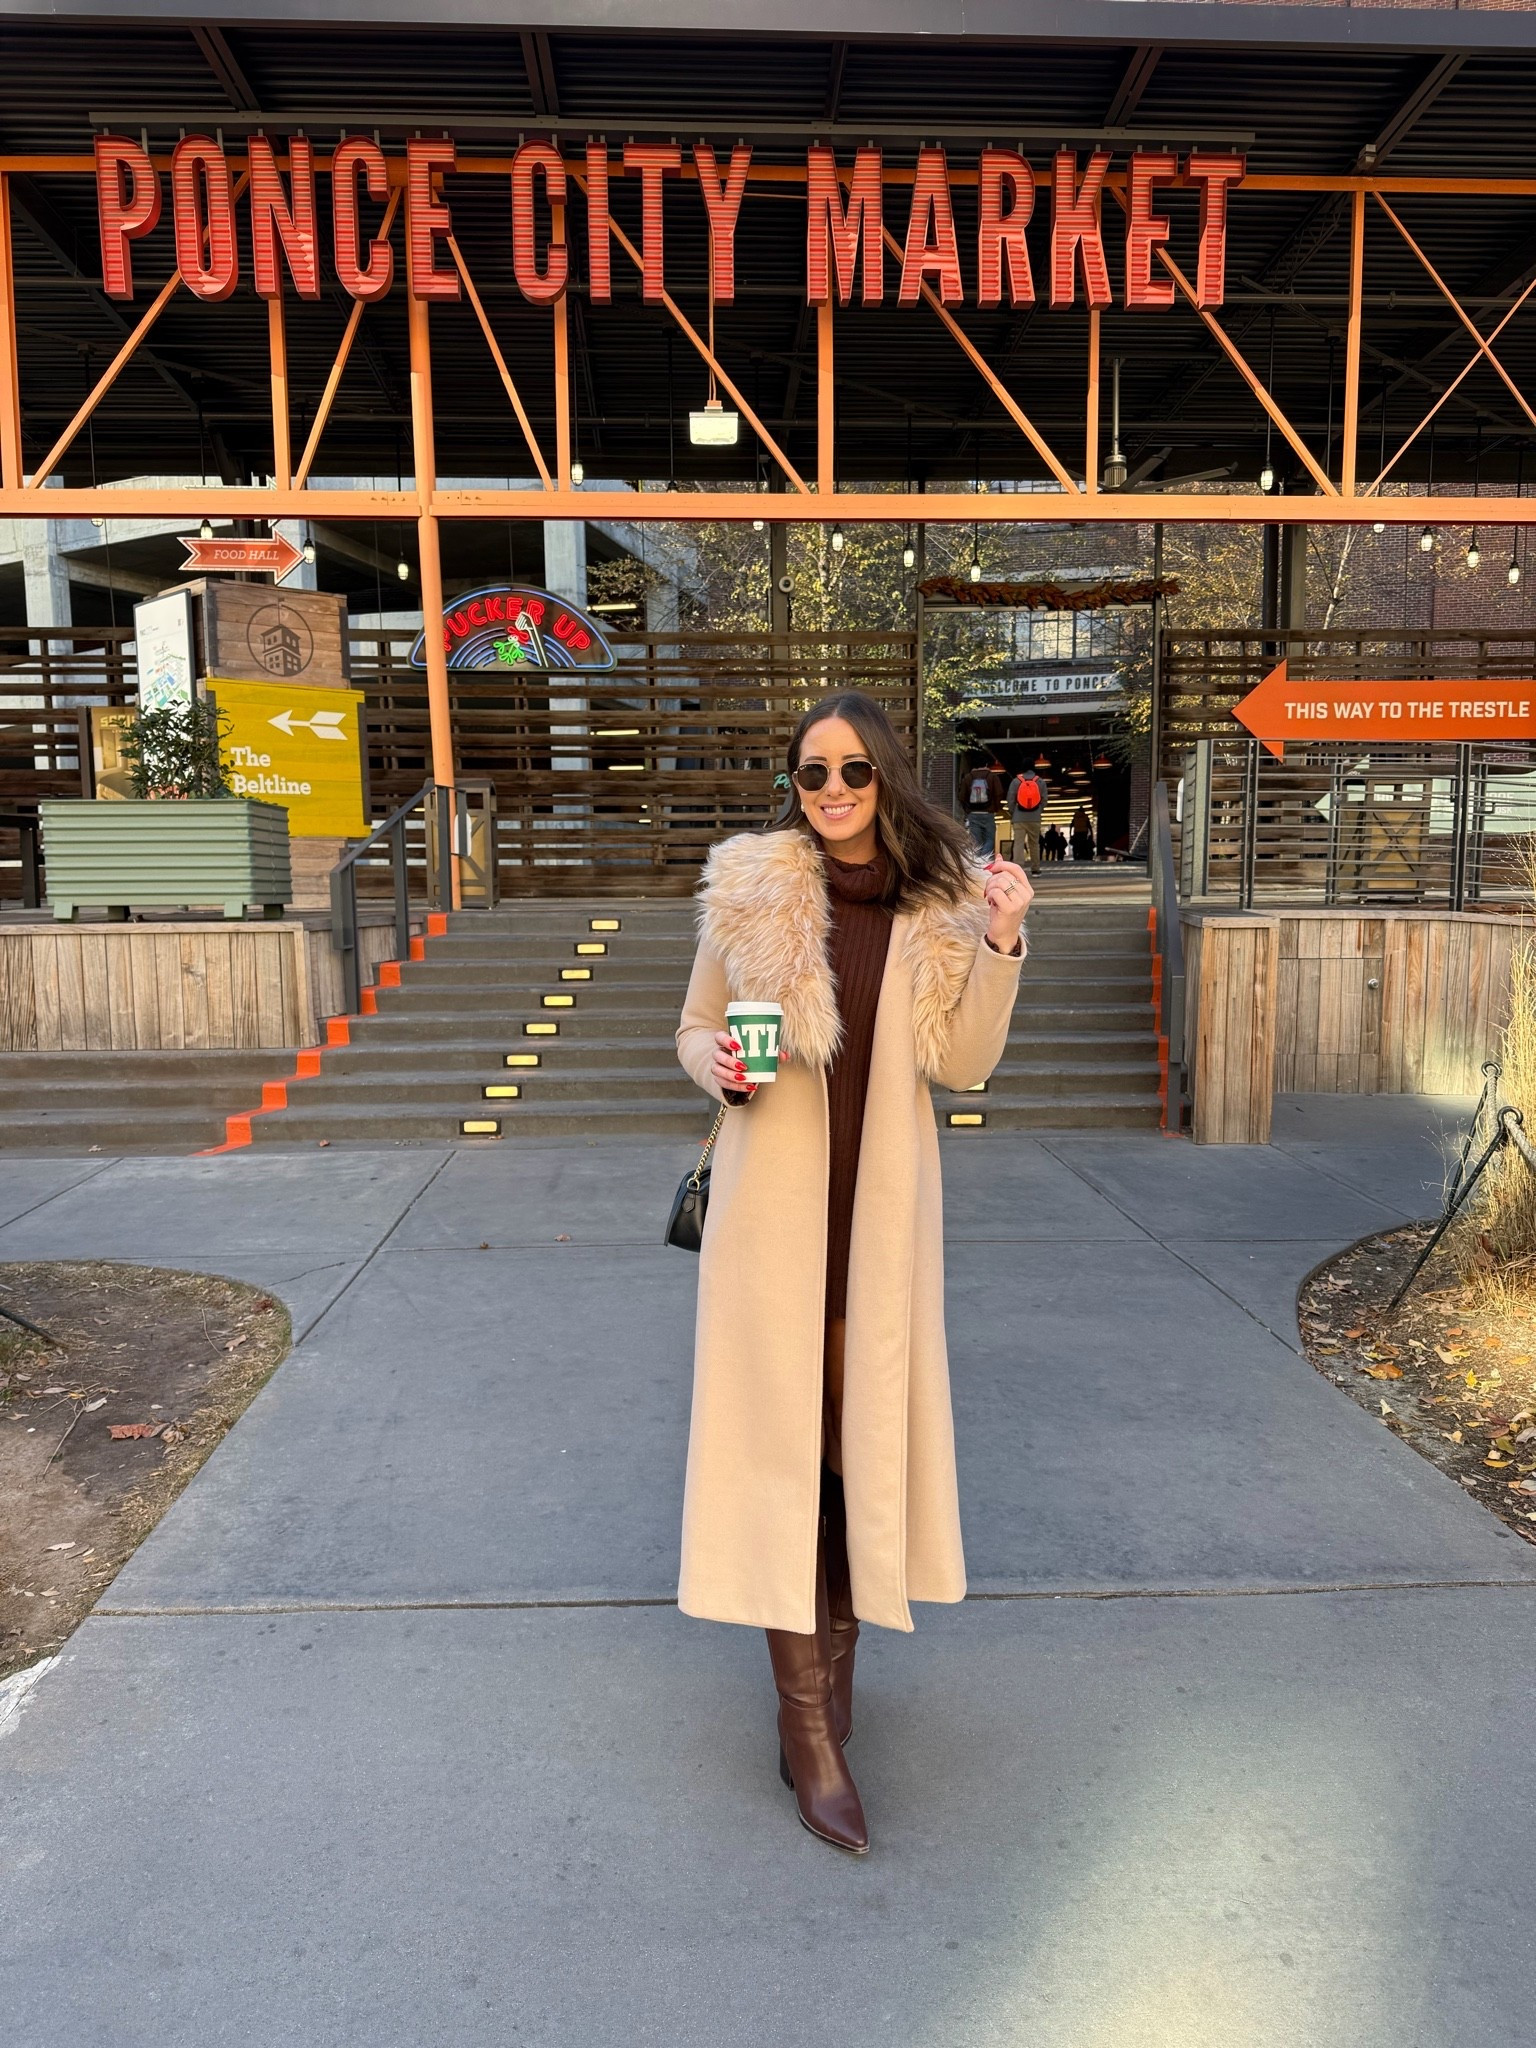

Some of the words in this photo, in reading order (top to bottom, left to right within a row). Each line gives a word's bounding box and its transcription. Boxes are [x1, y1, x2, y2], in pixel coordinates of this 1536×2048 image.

[93, 134, 462, 303] PONCE
[511, 138, 753, 307] CITY
[806, 145, 1247, 312] MARKET
[213, 549, 247, 560] FOOD
[248, 550, 280, 561] HALL
[553, 613, 591, 650] UP
[1045, 678, 1060, 691] TO
[1065, 676, 1107, 691] PONCE
[1284, 702, 1328, 720] THIS
[1333, 702, 1374, 719] WAY
[1378, 702, 1402, 719] TO
[1407, 702, 1444, 719] THE
[1449, 701, 1530, 718] TRESTLE
[230, 745, 271, 768] The
[232, 772, 312, 796] Beltline
[729, 1024, 779, 1058] ATL
